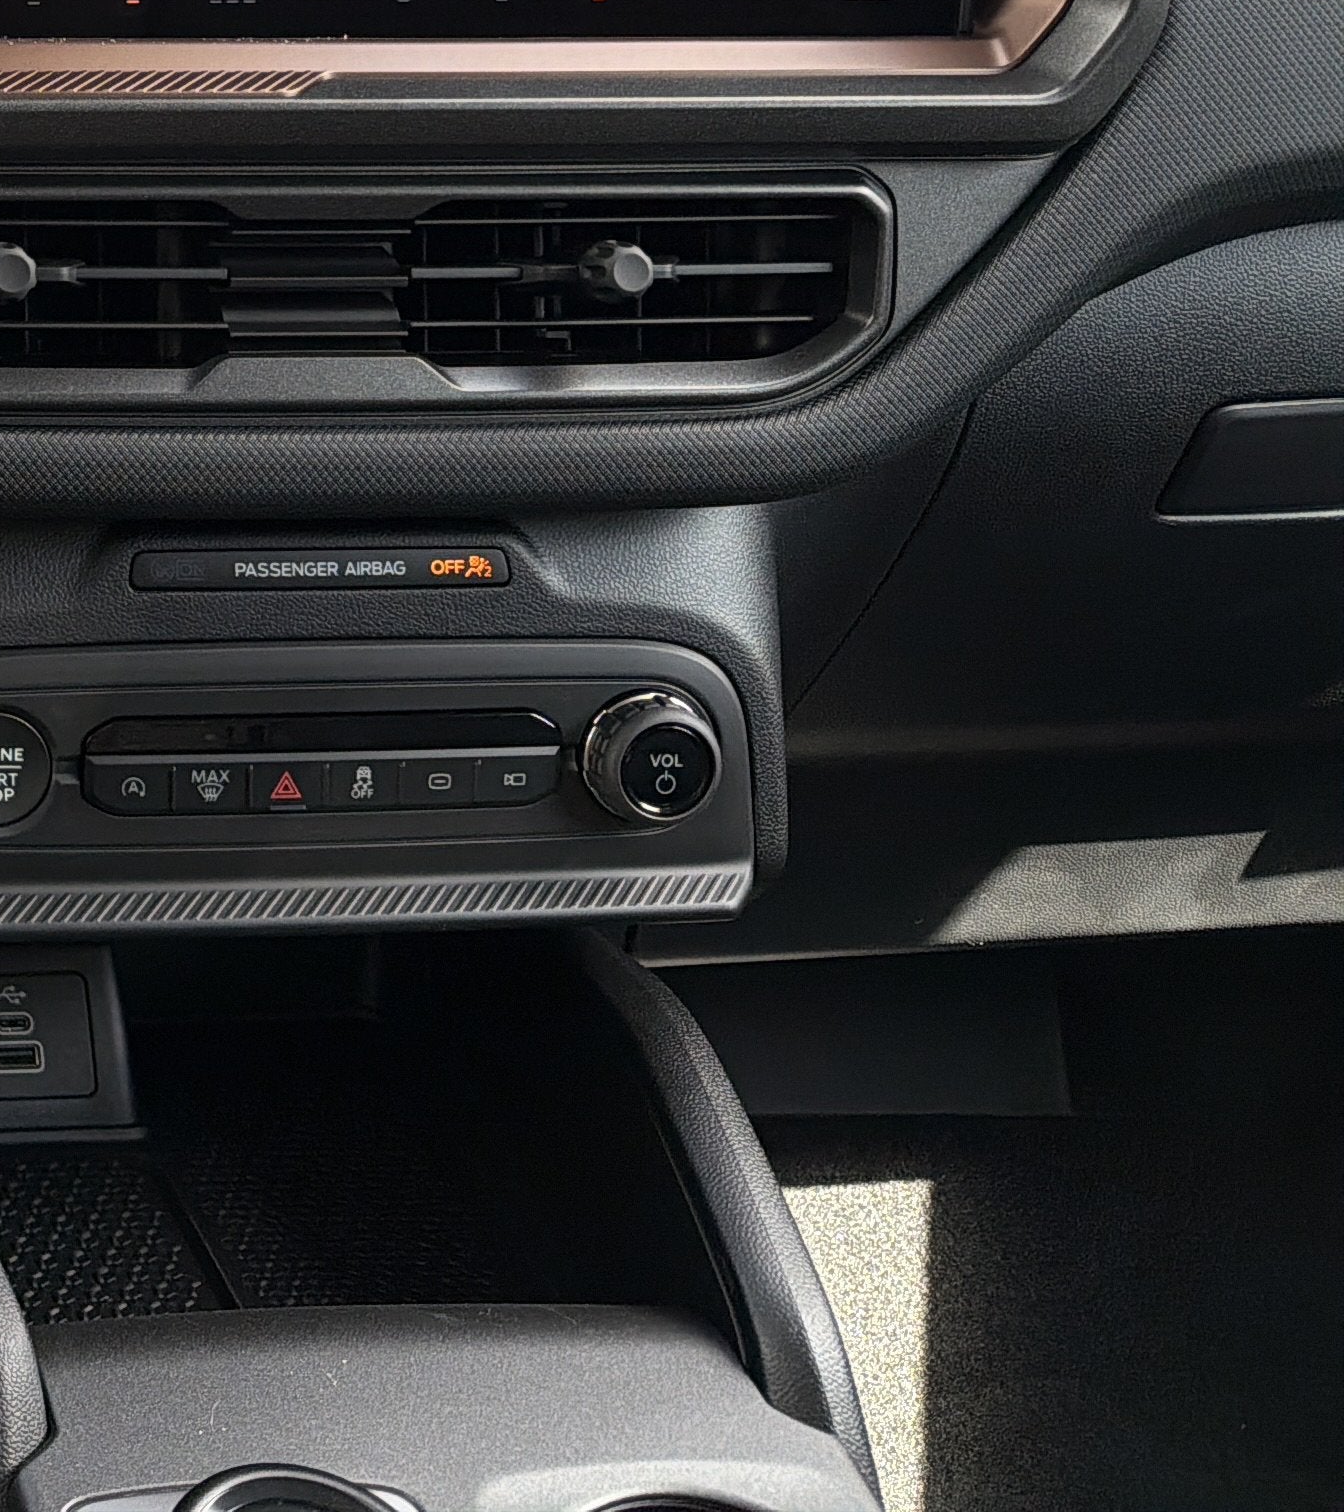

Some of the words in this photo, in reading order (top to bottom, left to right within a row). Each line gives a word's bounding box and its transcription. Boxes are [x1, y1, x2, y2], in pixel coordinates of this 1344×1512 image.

[233, 560, 340, 578] PASSENGER
[344, 559, 407, 577] AIRBAG
[430, 559, 466, 577] OFF
[649, 753, 684, 769] VOL
[190, 769, 231, 784] MAX
[350, 787, 375, 800] OFF
